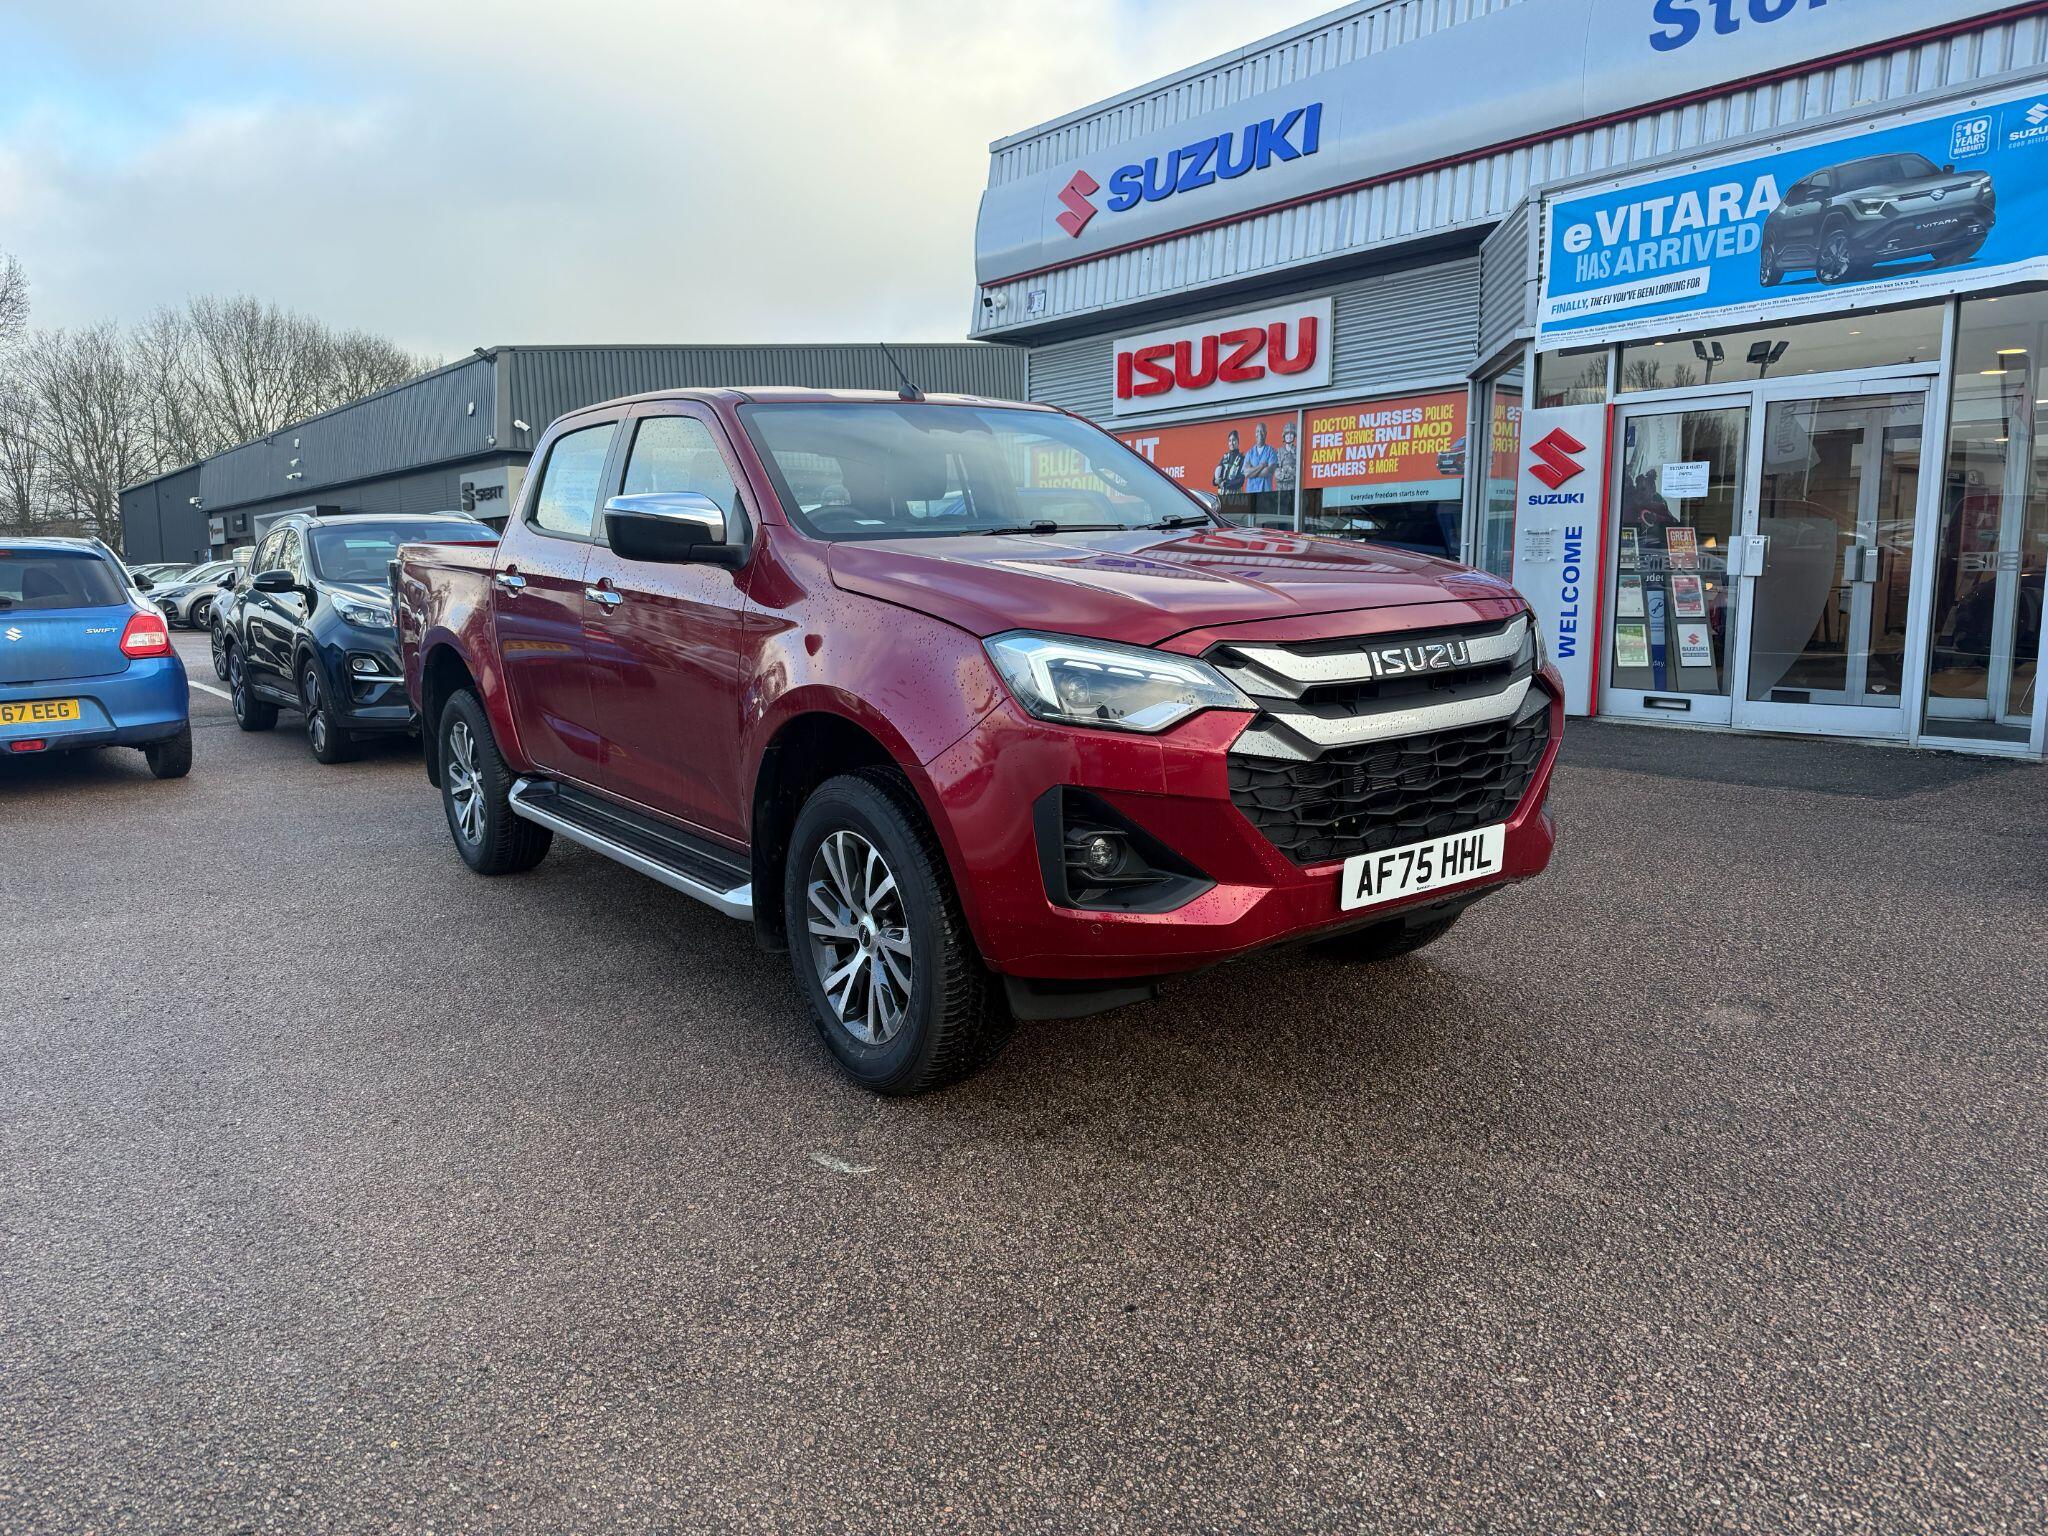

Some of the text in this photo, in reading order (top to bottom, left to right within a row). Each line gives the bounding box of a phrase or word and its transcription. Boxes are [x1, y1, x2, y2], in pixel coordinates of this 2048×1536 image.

[1649, 0, 1828, 51] Sto
[1955, 132, 1986, 148] YEARS
[1962, 120, 1988, 136] 10
[1107, 102, 1323, 213] SUZUKI
[1953, 143, 1985, 155] WARRANTY
[1575, 222, 1761, 283] HAS ARRIVED
[1551, 276, 1701, 315] FINALLY, THE EV YOU'VE BEEN LOOKING FOR
[1117, 316, 1318, 399] ISUZU
[1313, 403, 1455, 433] DOCTOR NURSES POLICE
[1312, 421, 1453, 449] FIRE SERVICE RNLI MOD
[1038, 448, 1080, 478] BLUE
[1312, 437, 1451, 464] ARMY NAVY AIR FORCE
[1311, 457, 1399, 479] TEACHERS & MORE
[476, 485, 504, 502] SEAT
[1375, 491, 1397, 499] freedom
[1528, 493, 1584, 505] SUZUKI
[1670, 530, 1693, 541] GREAT
[1558, 525, 1583, 659] WELCOME
[85, 627, 118, 635] SWIFT
[1372, 640, 1470, 677] ISUZU
[1, 702, 70, 721] 67 EEG
[1356, 833, 1492, 899] AF75 HHL
